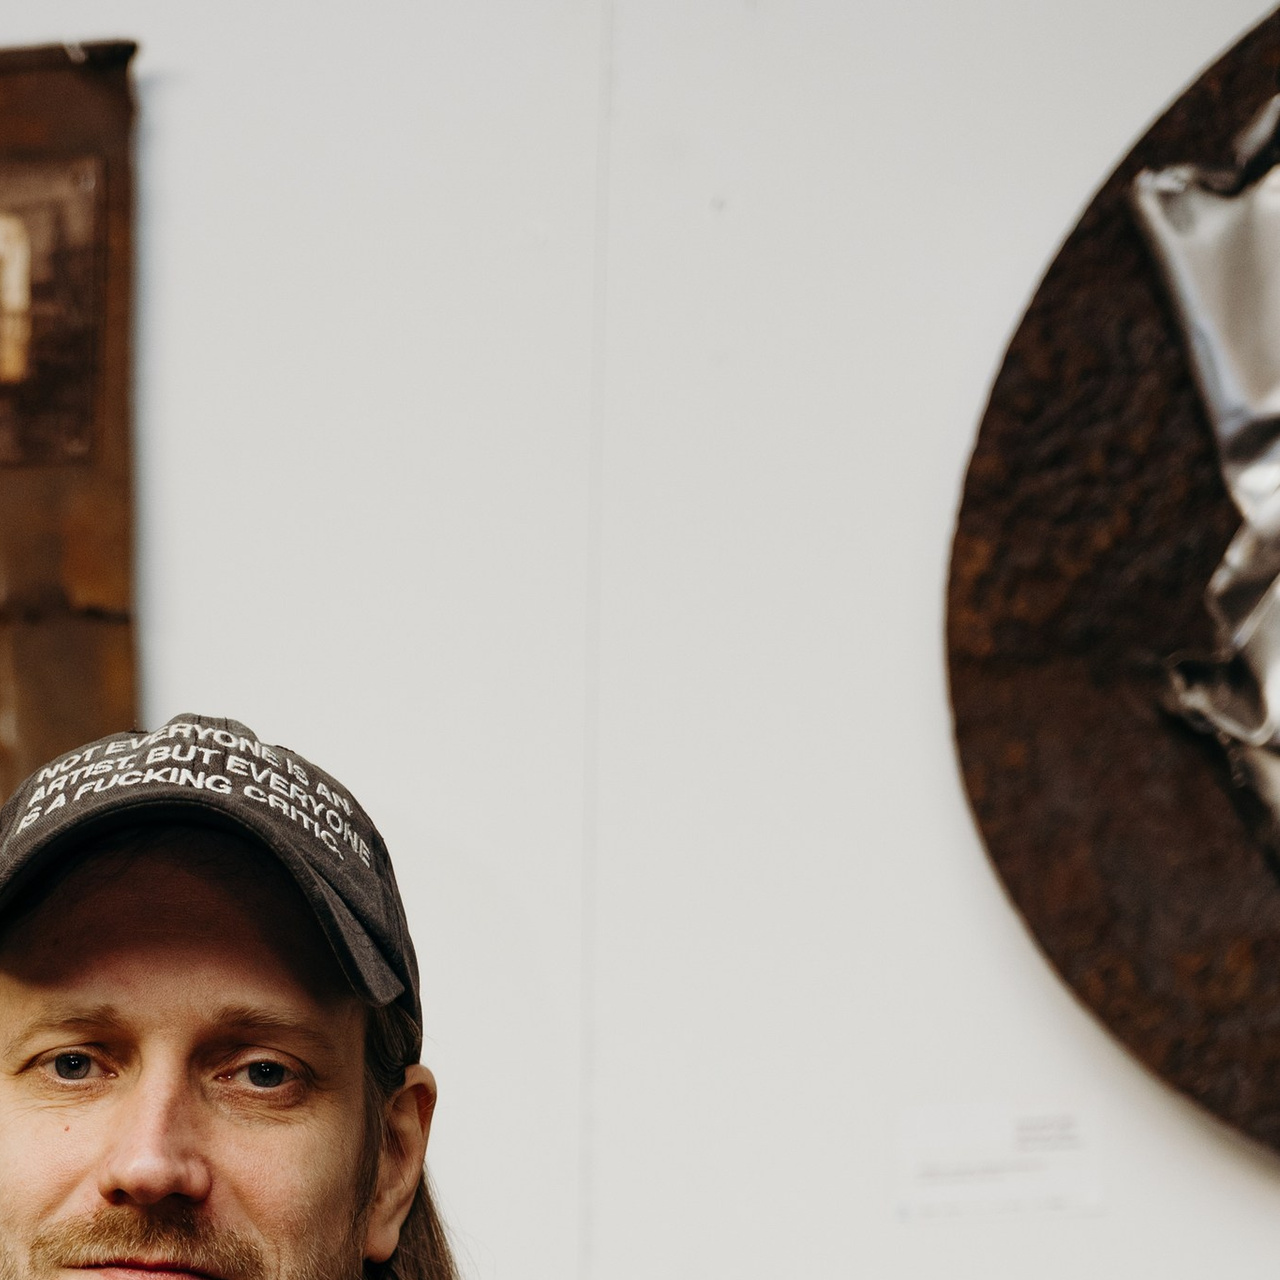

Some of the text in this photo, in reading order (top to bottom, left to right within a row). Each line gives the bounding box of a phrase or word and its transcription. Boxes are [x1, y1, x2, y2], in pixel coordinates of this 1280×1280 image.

[15, 807, 42, 835] IS
[44, 793, 67, 816] A
[73, 767, 232, 802] FUCKING
[27, 744, 371, 869] ARTIST, BUT EVERYONE
[38, 723, 353, 816] NOT EVERYONE IS AN
